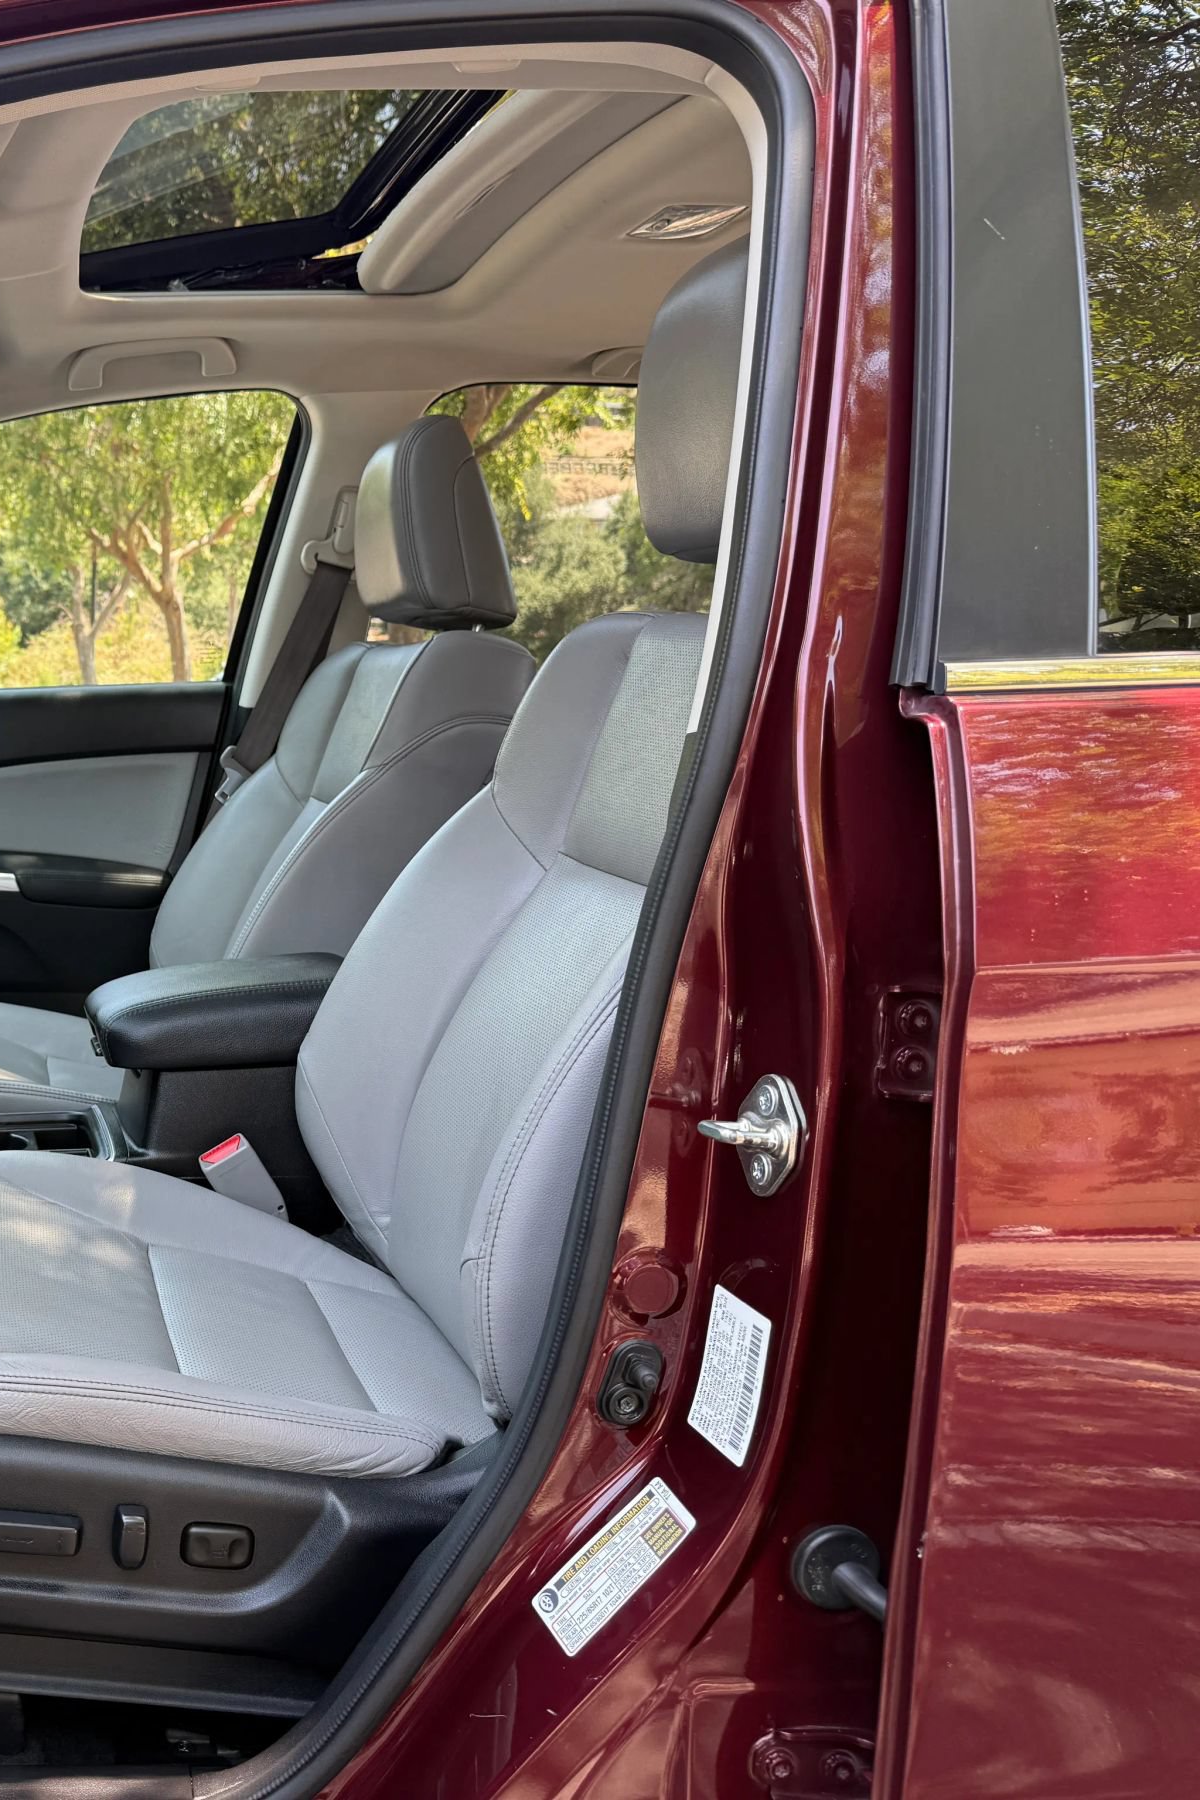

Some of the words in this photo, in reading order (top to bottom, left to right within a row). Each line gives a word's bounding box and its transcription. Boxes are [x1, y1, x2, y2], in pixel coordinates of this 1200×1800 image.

[698, 1374, 706, 1399] CANADA
[710, 1309, 718, 1333] CANADA
[710, 1330, 719, 1355] CANADA
[561, 1567, 576, 1583] TIRE
[573, 1555, 588, 1571] AND
[586, 1531, 612, 1558] LOADING
[611, 1495, 650, 1535] INFORMATION
[643, 1530, 653, 1541] SEE
[651, 1512, 670, 1533] OWNER'S
[648, 1526, 666, 1546] MANUAL
[664, 1517, 675, 1528] FOR
[652, 1523, 679, 1551] ADDITIONAL
[624, 1538, 642, 1558] PRESSURE
[656, 1527, 684, 1557] INFORMATION
[565, 1575, 582, 1593] SEATING
[582, 1557, 601, 1576] CAPACITY
[576, 1595, 603, 1625] 225/65R17
[602, 1582, 616, 1598] 102T
[583, 1588, 594, 1601] SIZE
[560, 1620, 574, 1636] FRONT
[565, 1627, 578, 1642] REAR
[569, 1632, 584, 1650] SPARE
